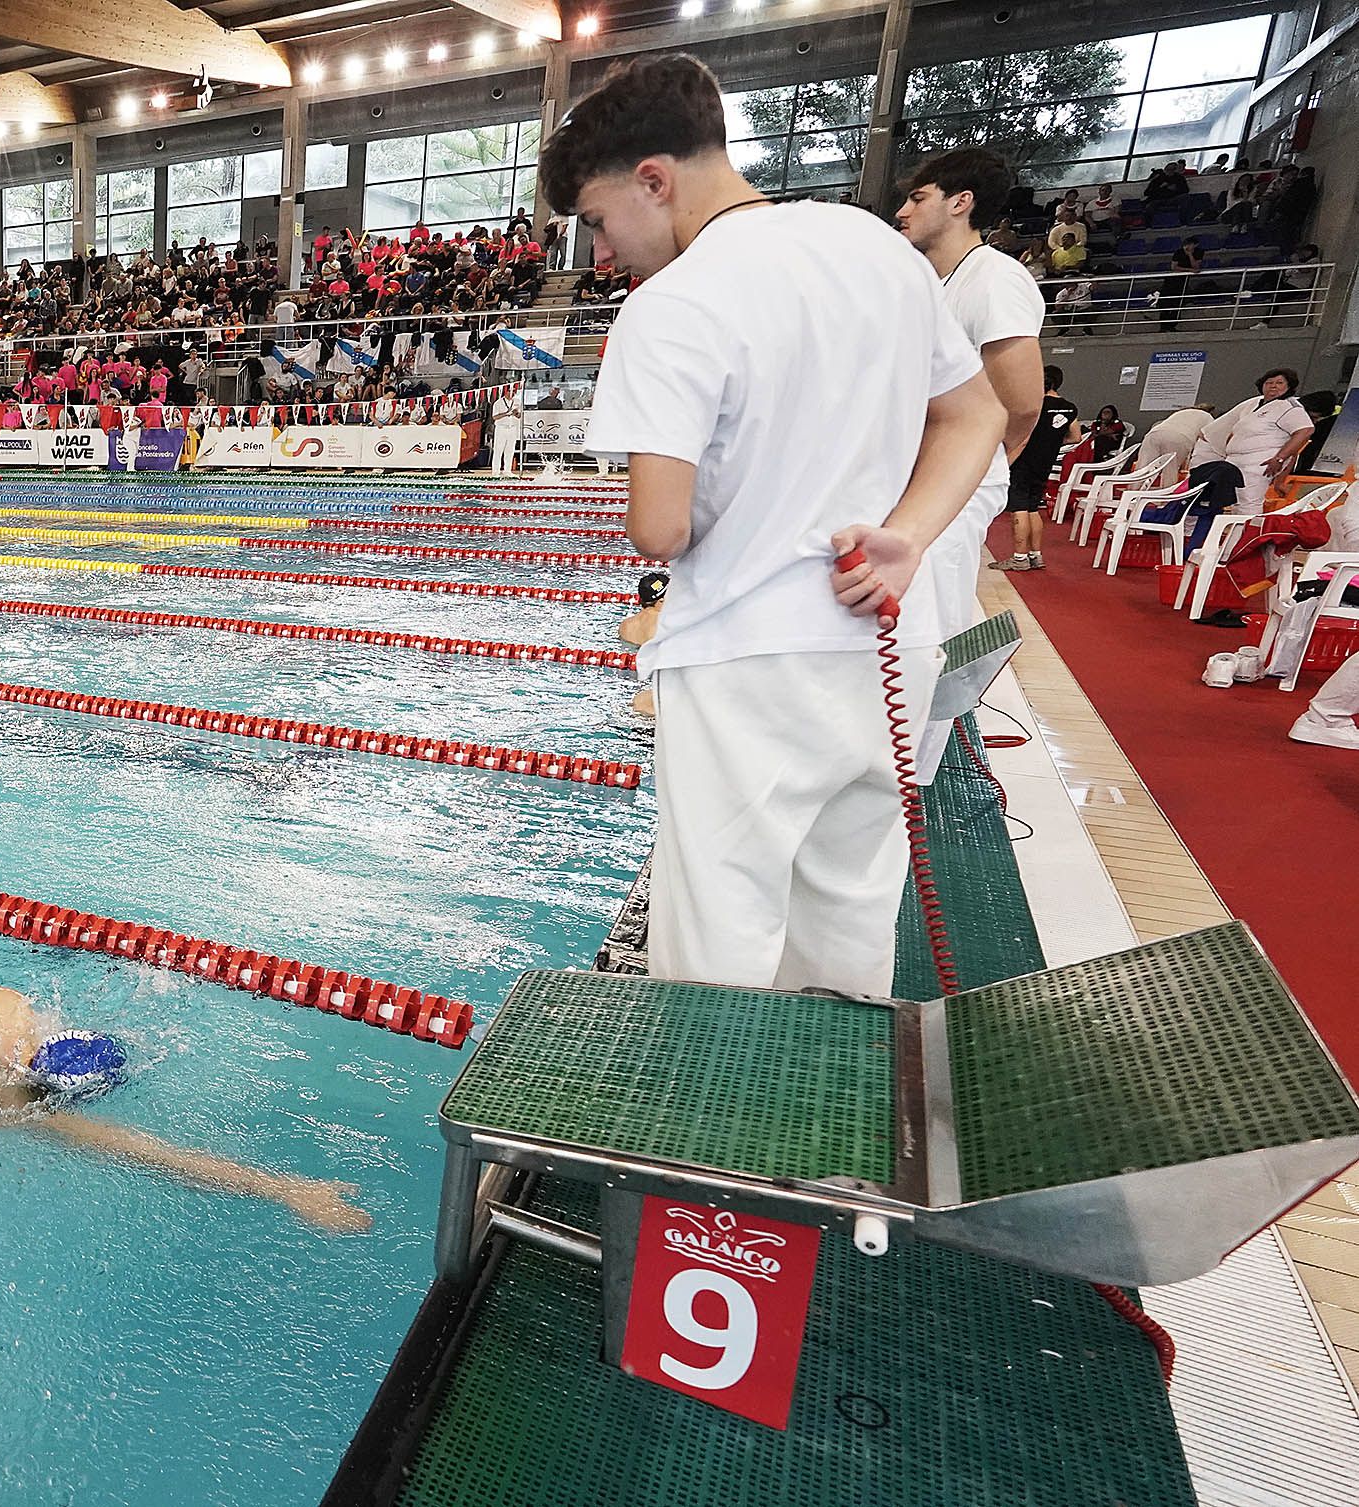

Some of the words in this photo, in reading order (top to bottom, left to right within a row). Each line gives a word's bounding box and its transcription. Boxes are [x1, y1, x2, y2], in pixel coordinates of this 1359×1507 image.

[51, 448, 95, 459] WAVE
[55, 435, 91, 446] MAD
[664, 1228, 782, 1274] GALAICO
[660, 1268, 759, 1391] 9
